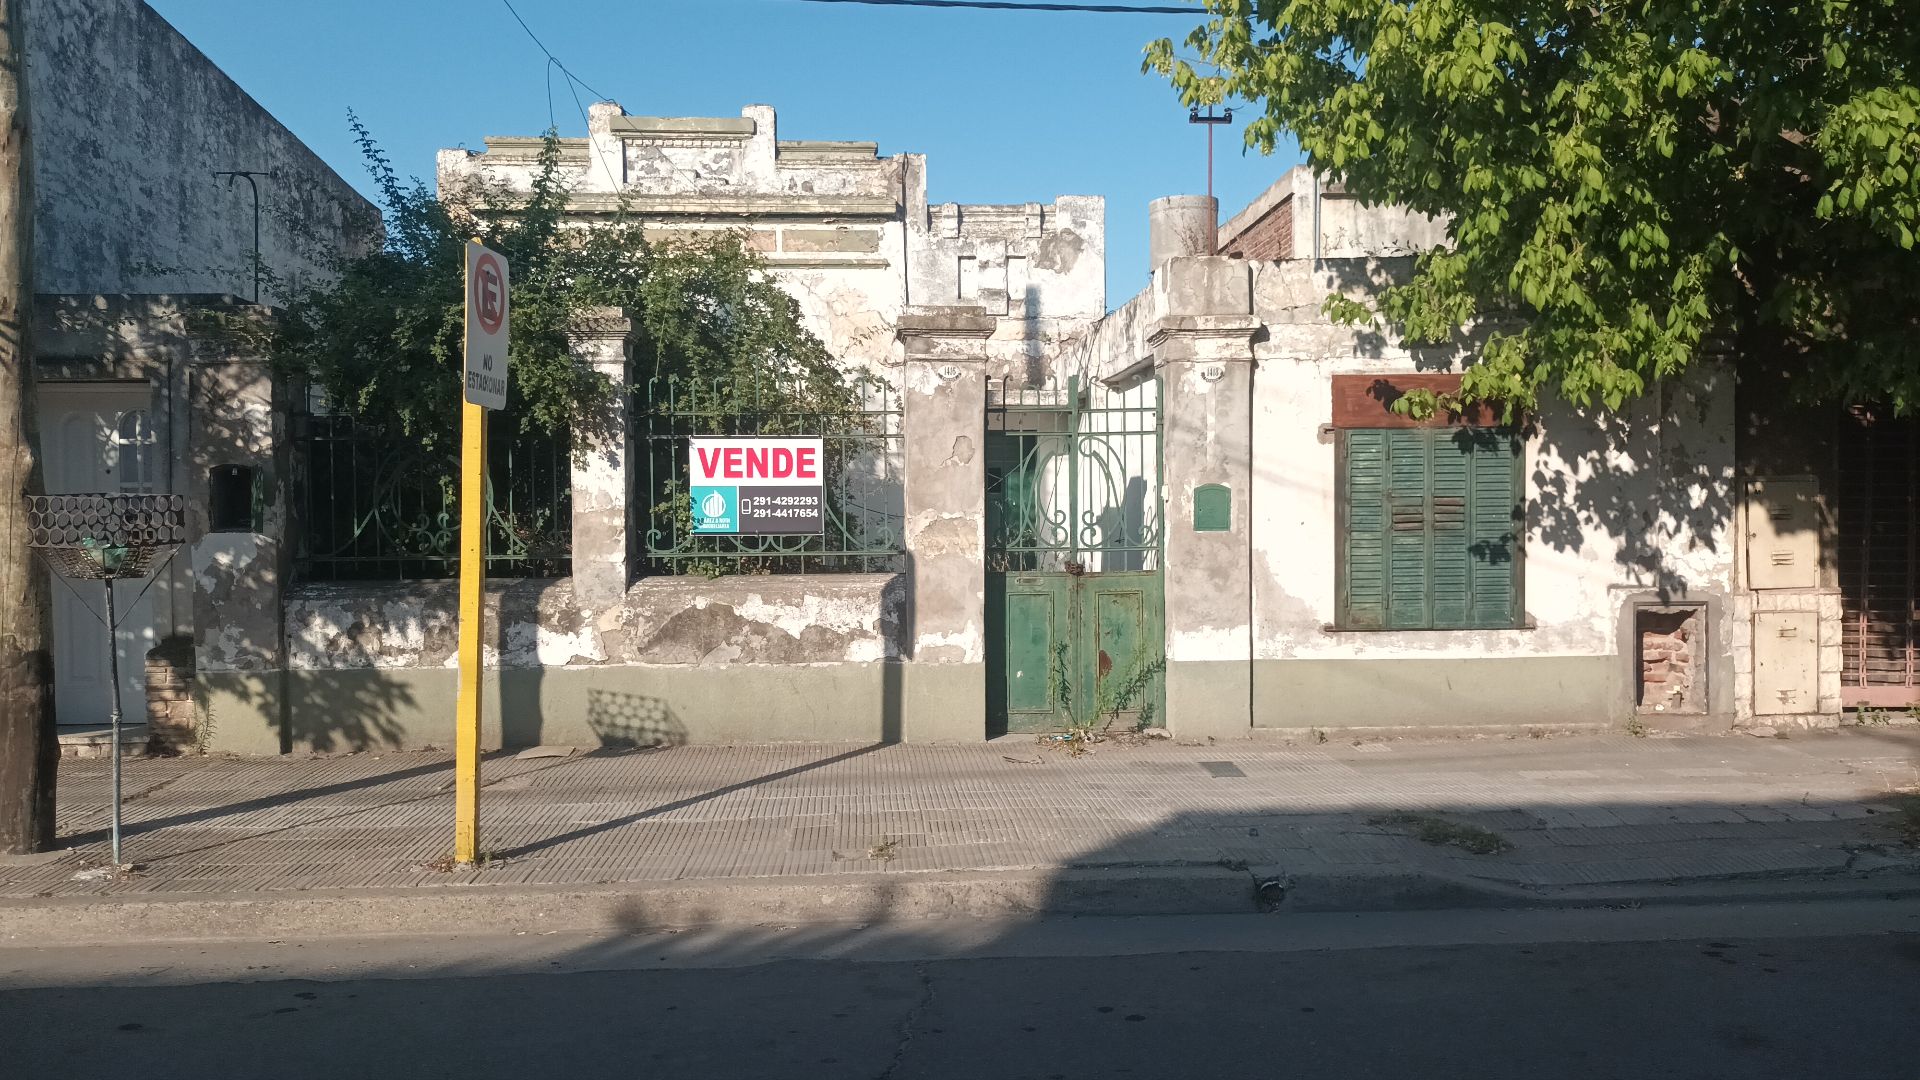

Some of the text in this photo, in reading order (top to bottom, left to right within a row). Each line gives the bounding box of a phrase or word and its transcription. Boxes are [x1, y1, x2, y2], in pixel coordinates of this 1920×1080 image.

[483, 354, 493, 371] NO
[468, 371, 505, 396] ESTACIONAR
[697, 447, 816, 479] VENDE
[753, 496, 819, 506] 291-4292293
[753, 508, 819, 518] 291-4417654
